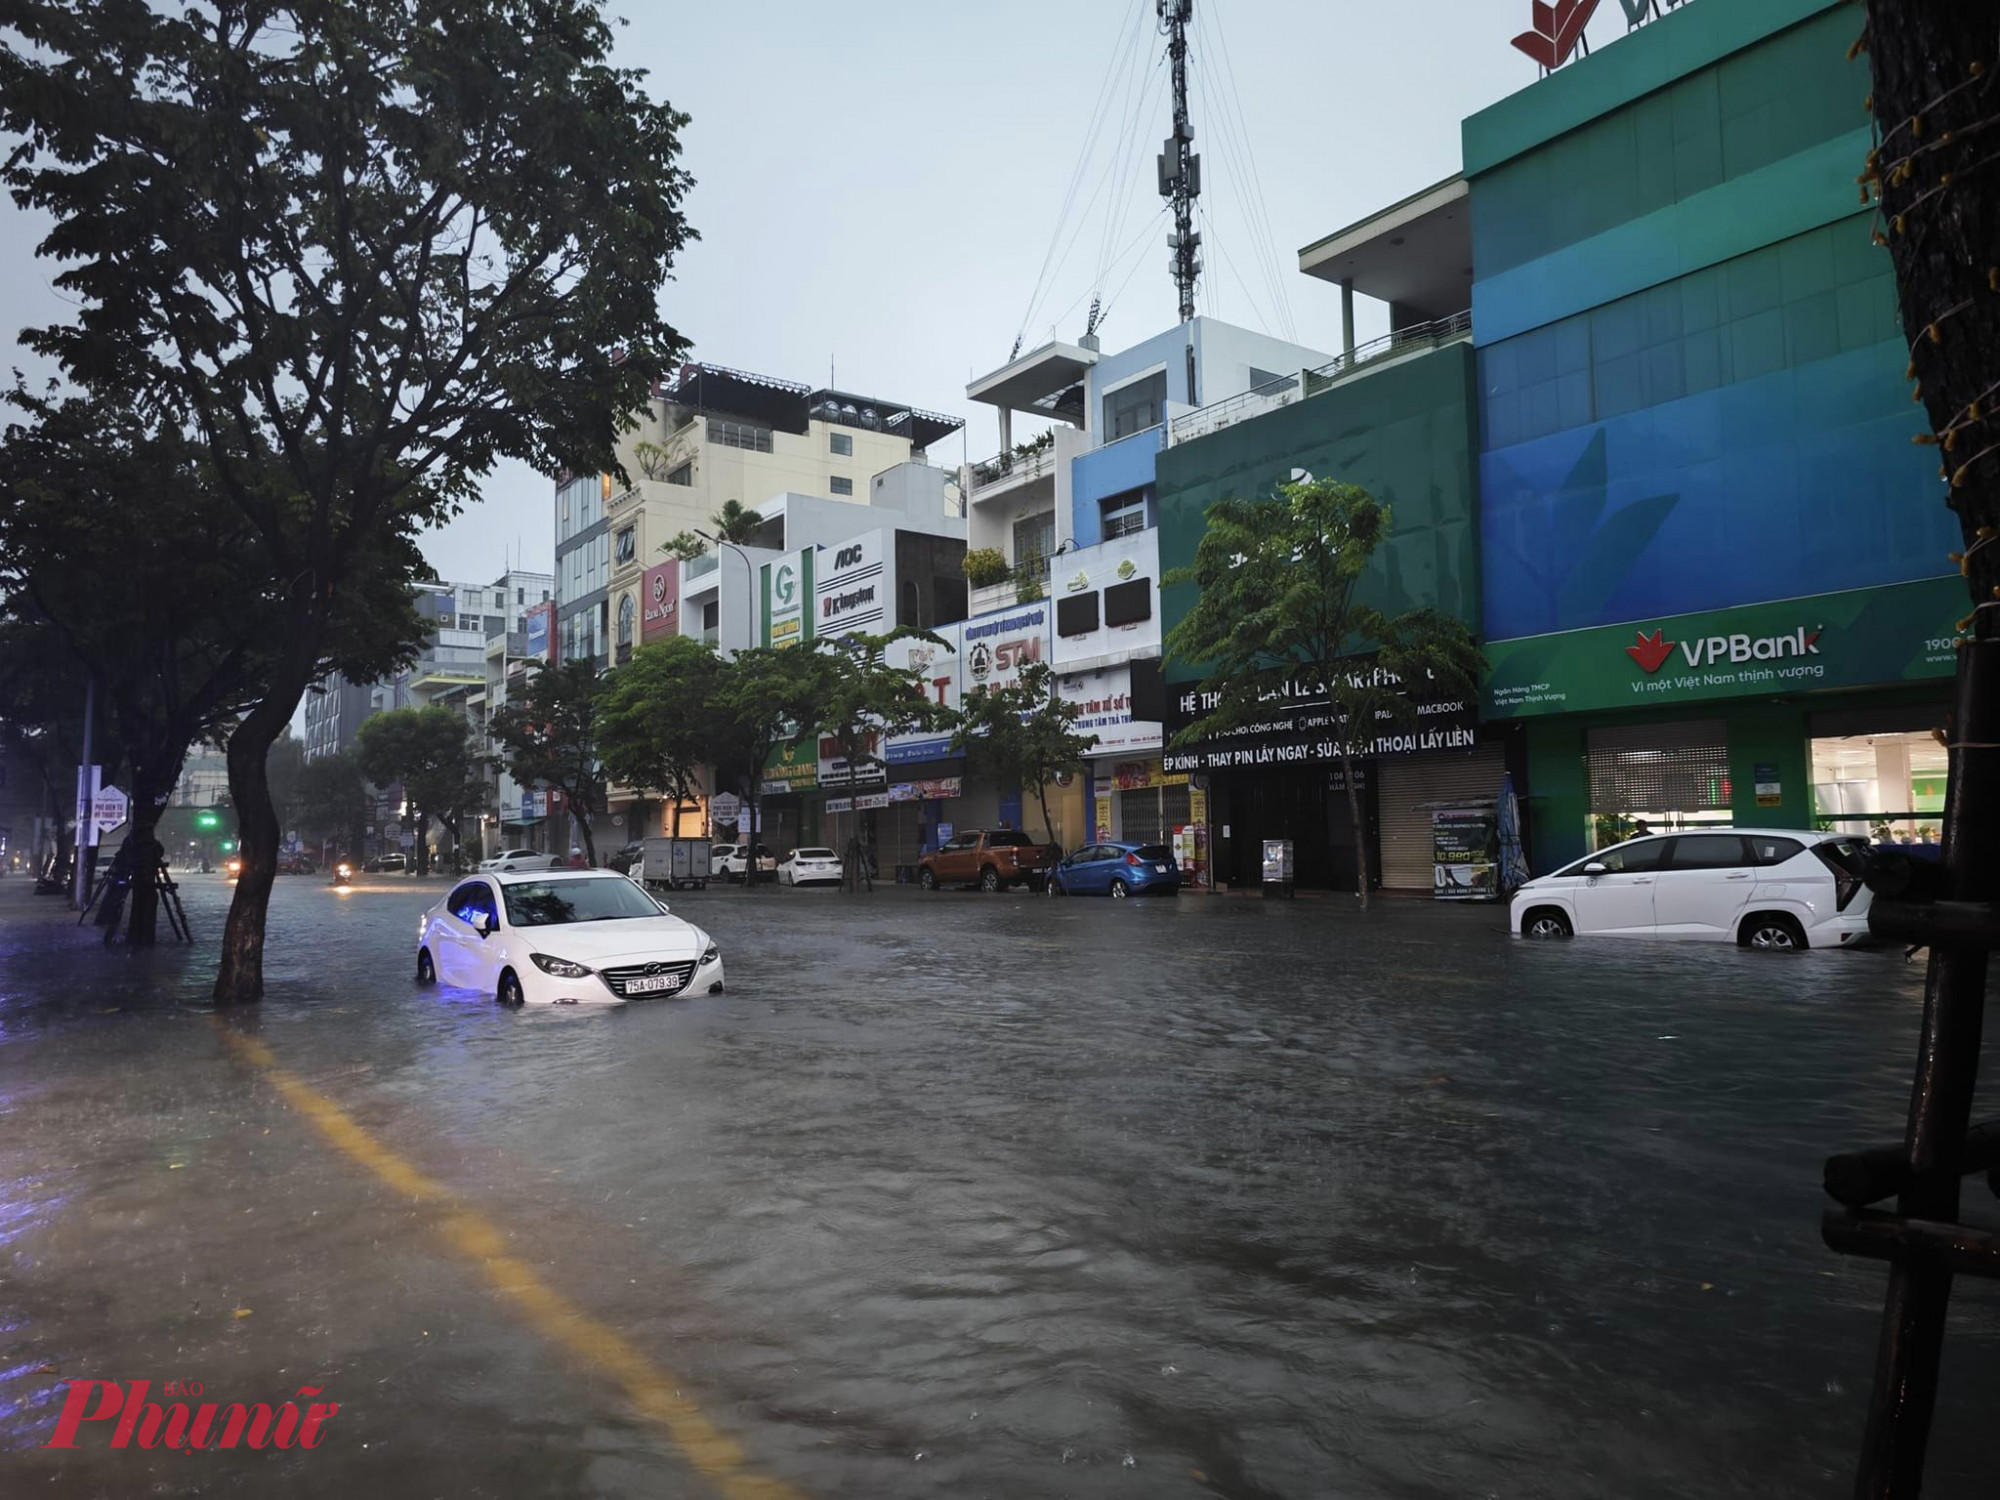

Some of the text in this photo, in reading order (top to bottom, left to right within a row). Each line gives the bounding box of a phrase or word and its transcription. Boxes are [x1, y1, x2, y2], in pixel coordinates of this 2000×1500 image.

[834, 544, 862, 570] AOC
[832, 585, 875, 615] Kingston
[995, 636, 1040, 671] STM
[1680, 625, 1821, 668] VPBank
[1531, 683, 1551, 691] TMCP
[1631, 664, 1825, 693] Vì một Việt Nam thịnh vượng
[1180, 690, 1197, 715] HỆ
[1307, 716, 1329, 727] APPLE
[1417, 700, 1464, 716] MACBOOK
[1174, 752, 1199, 771] KÍNH
[1207, 753, 1233, 768] THAY
[1234, 751, 1254, 765] PIN
[1277, 744, 1309, 762] NGAY
[1377, 734, 1417, 754] THOẠI
[628, 976, 678, 991] 75A-079.39
